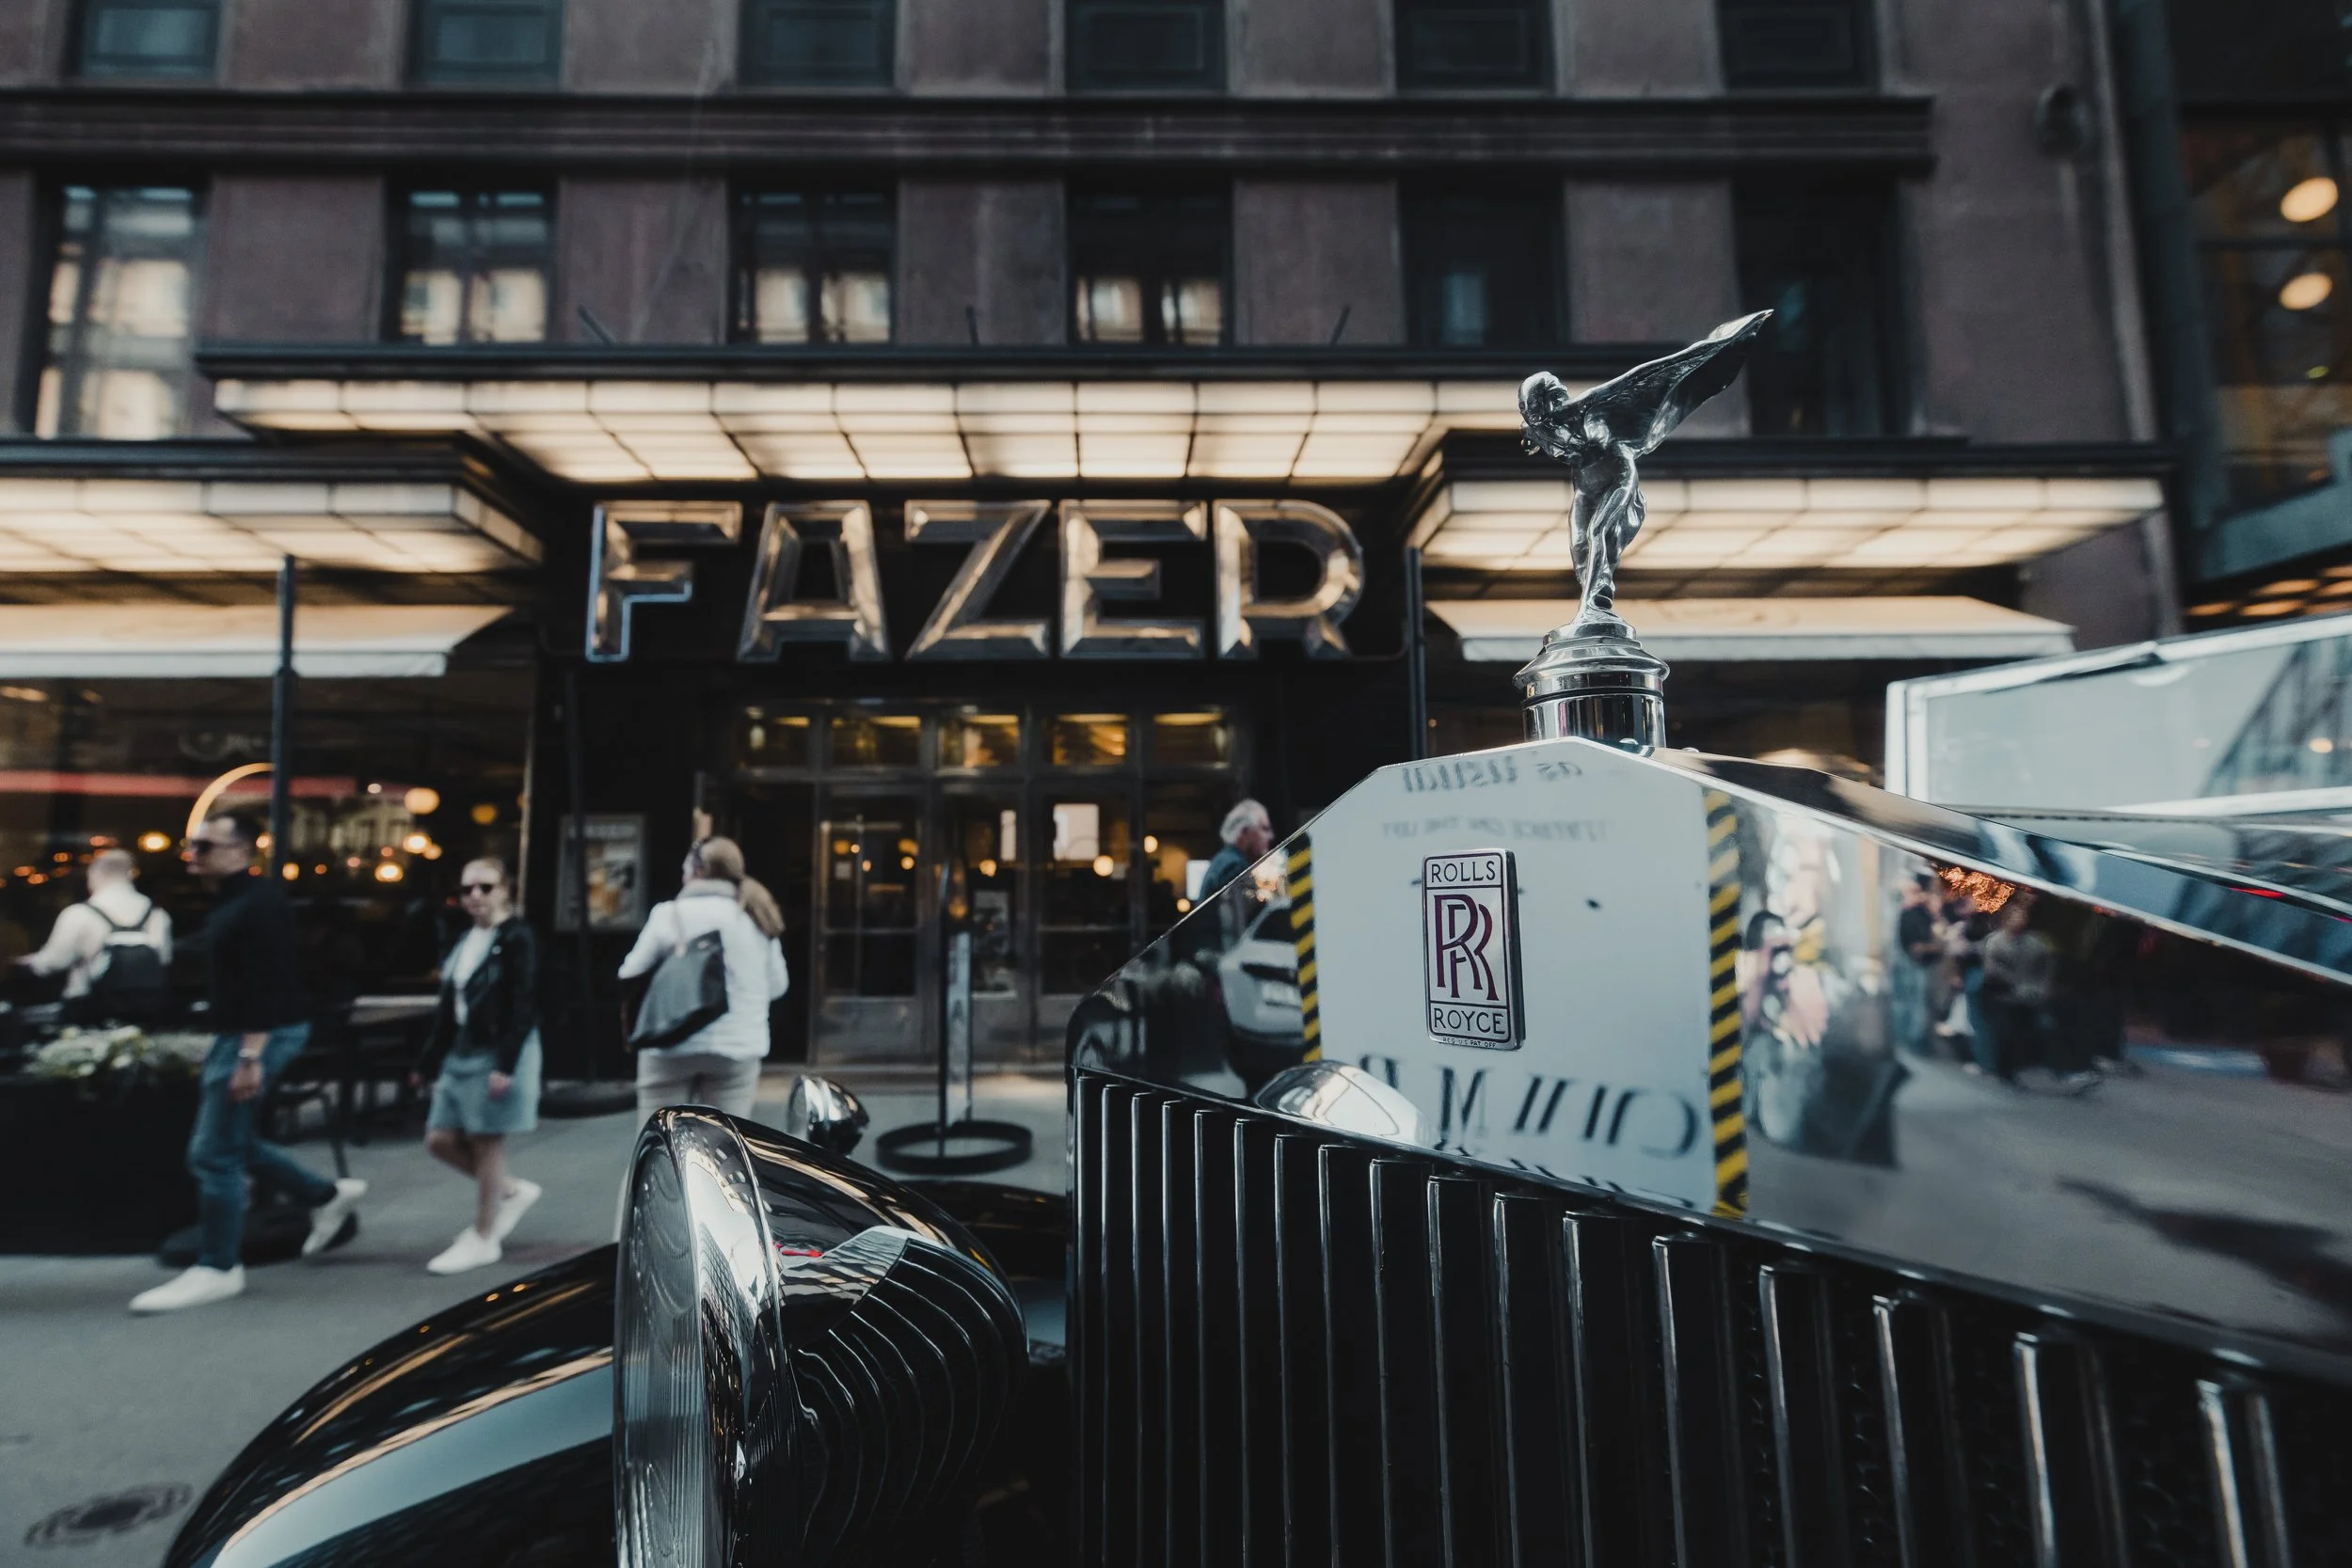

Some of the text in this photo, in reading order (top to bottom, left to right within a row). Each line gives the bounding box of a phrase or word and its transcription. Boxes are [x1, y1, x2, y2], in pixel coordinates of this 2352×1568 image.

[584, 499, 1364, 662] FAZER
[1431, 860, 1496, 883] ROLLS
[1433, 1007, 1505, 1035] ROYCE
